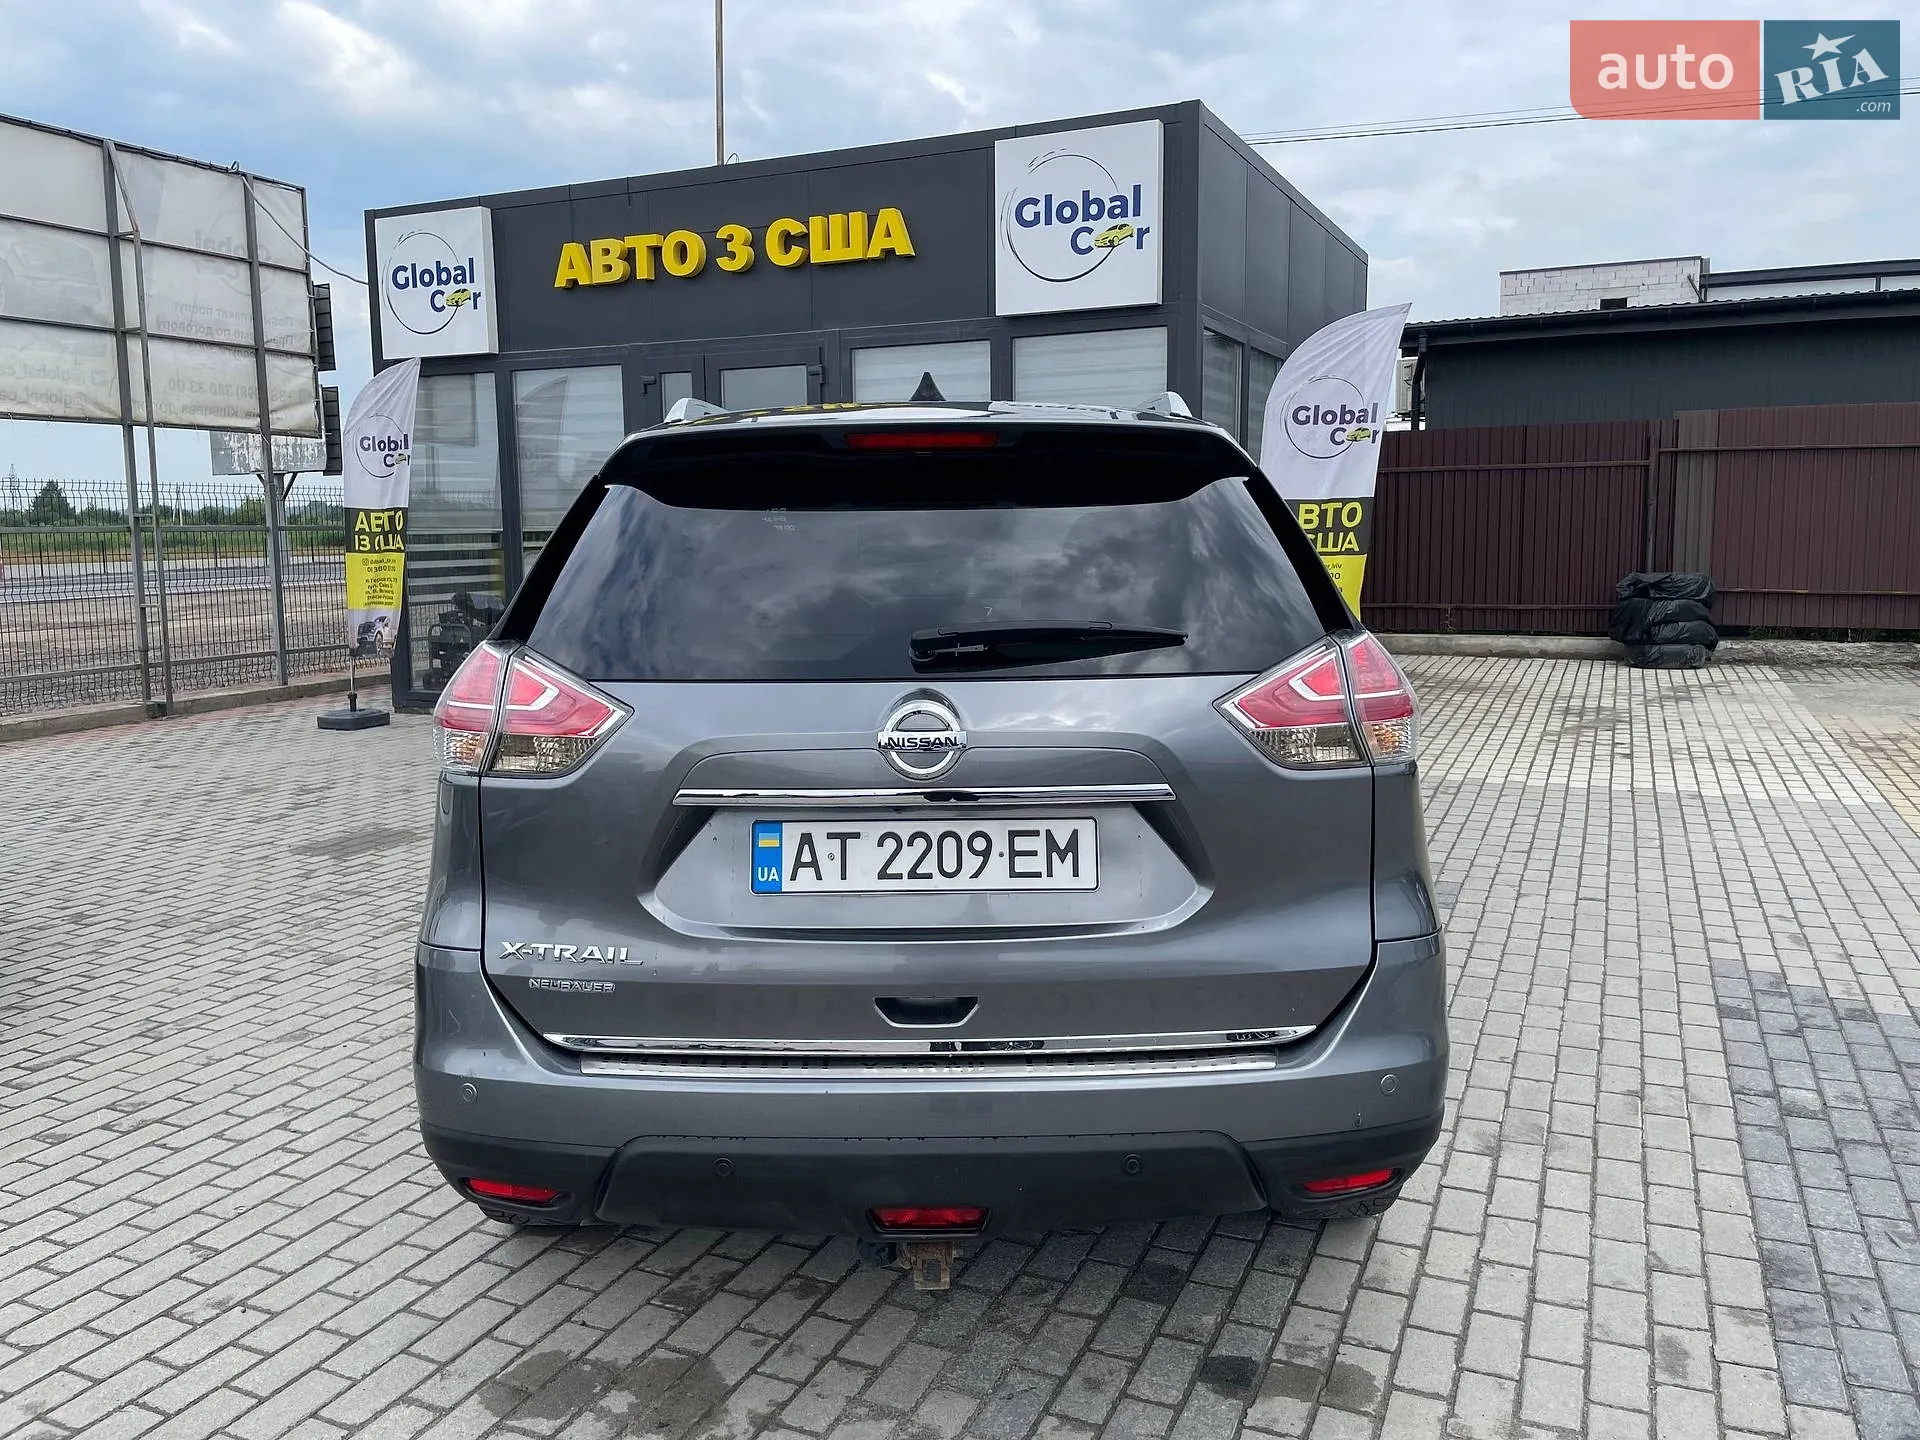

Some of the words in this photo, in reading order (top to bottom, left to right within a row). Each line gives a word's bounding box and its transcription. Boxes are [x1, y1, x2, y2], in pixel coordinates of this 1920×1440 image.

[1014, 183, 1143, 229] Global
[554, 230, 706, 290] АВТО
[716, 222, 756, 273] З
[765, 206, 917, 268] США
[391, 257, 475, 290] Global
[1291, 402, 1379, 426] Global
[1298, 501, 1363, 530] ВТО
[886, 736, 959, 749] NISSAN
[757, 867, 779, 882] UA
[789, 831, 861, 881] AT
[876, 829, 993, 881] 2209
[1007, 828, 1080, 879] EM
[499, 941, 644, 966] X-TRAIL
